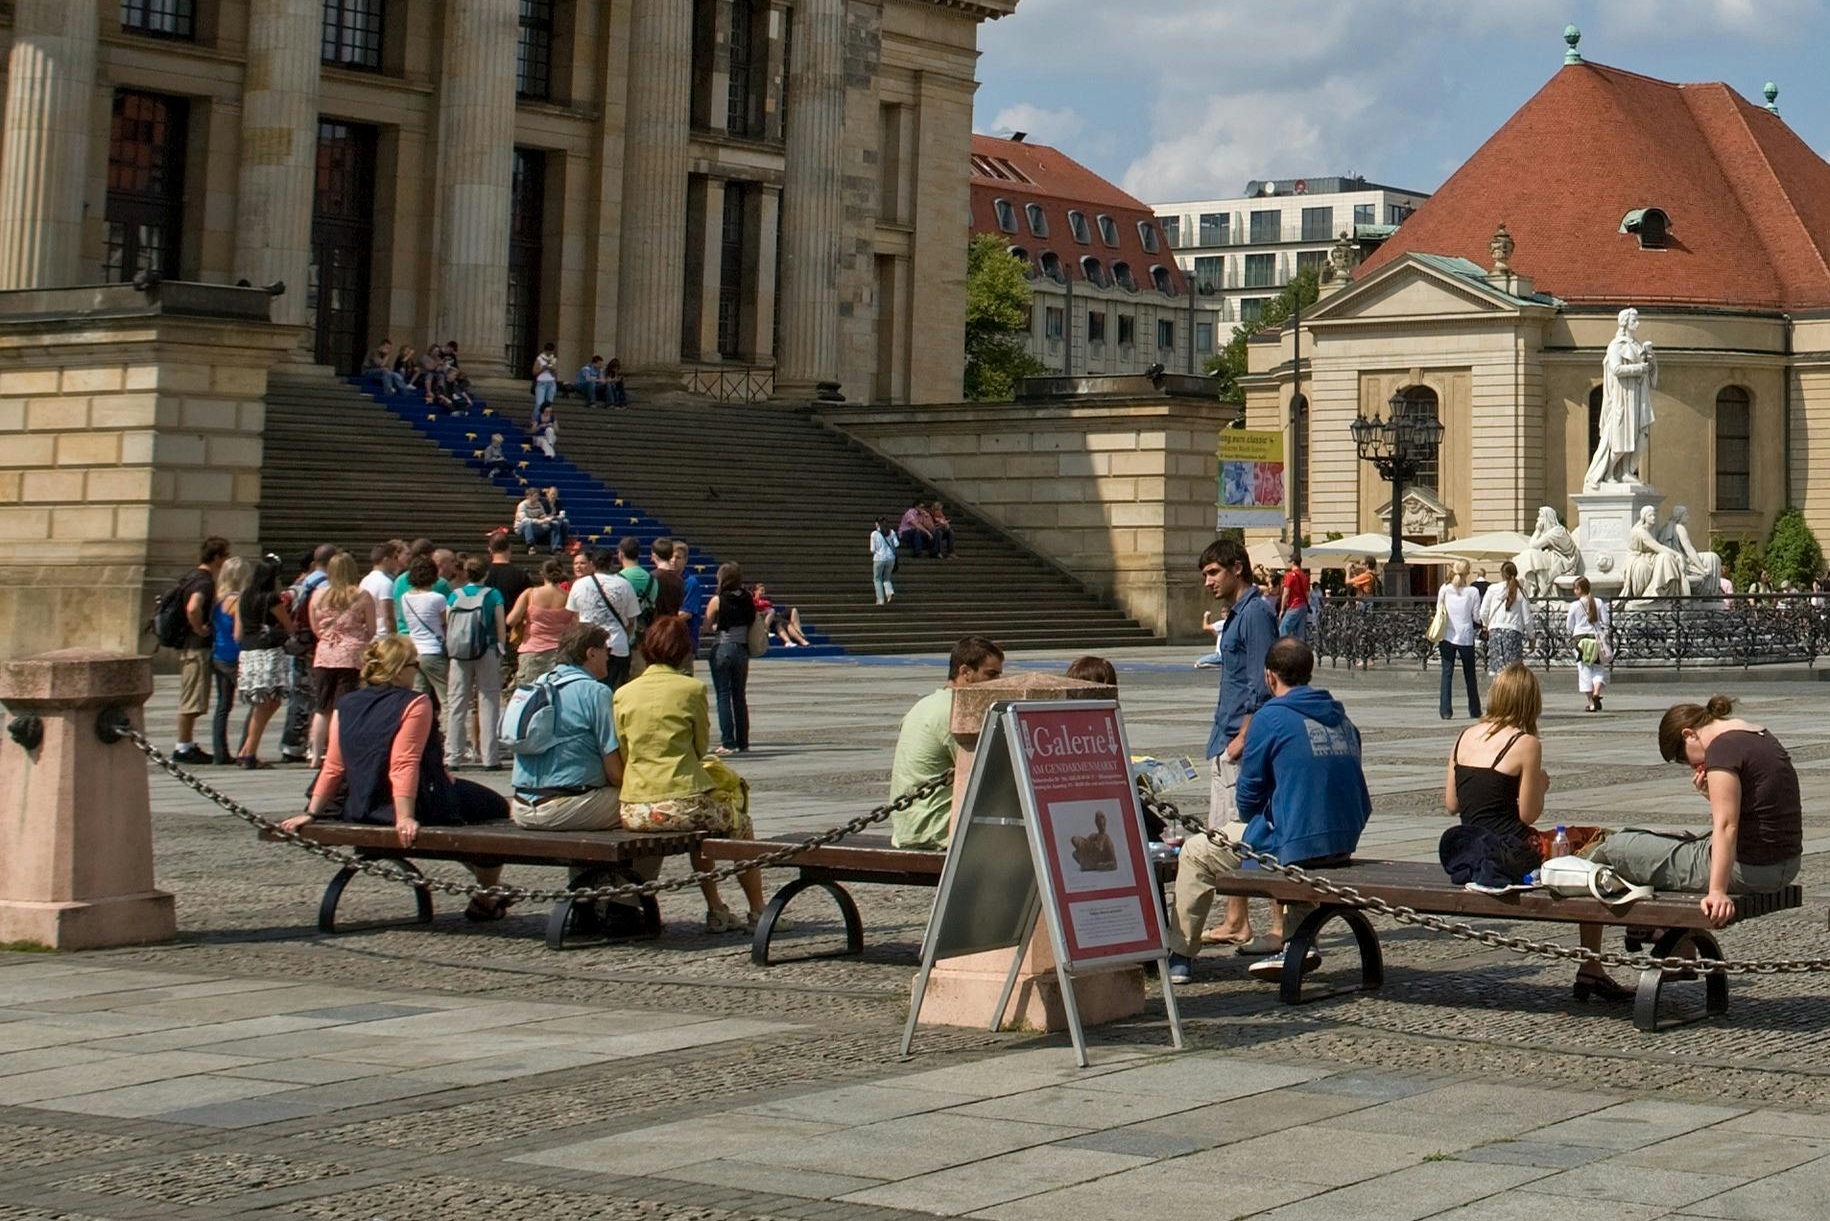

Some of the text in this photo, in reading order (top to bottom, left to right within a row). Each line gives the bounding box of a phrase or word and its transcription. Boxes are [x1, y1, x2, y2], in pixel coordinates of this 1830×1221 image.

[1033, 724, 1107, 757] Galerie
[1032, 760, 1118, 775] AM GENDARMENMARKT
